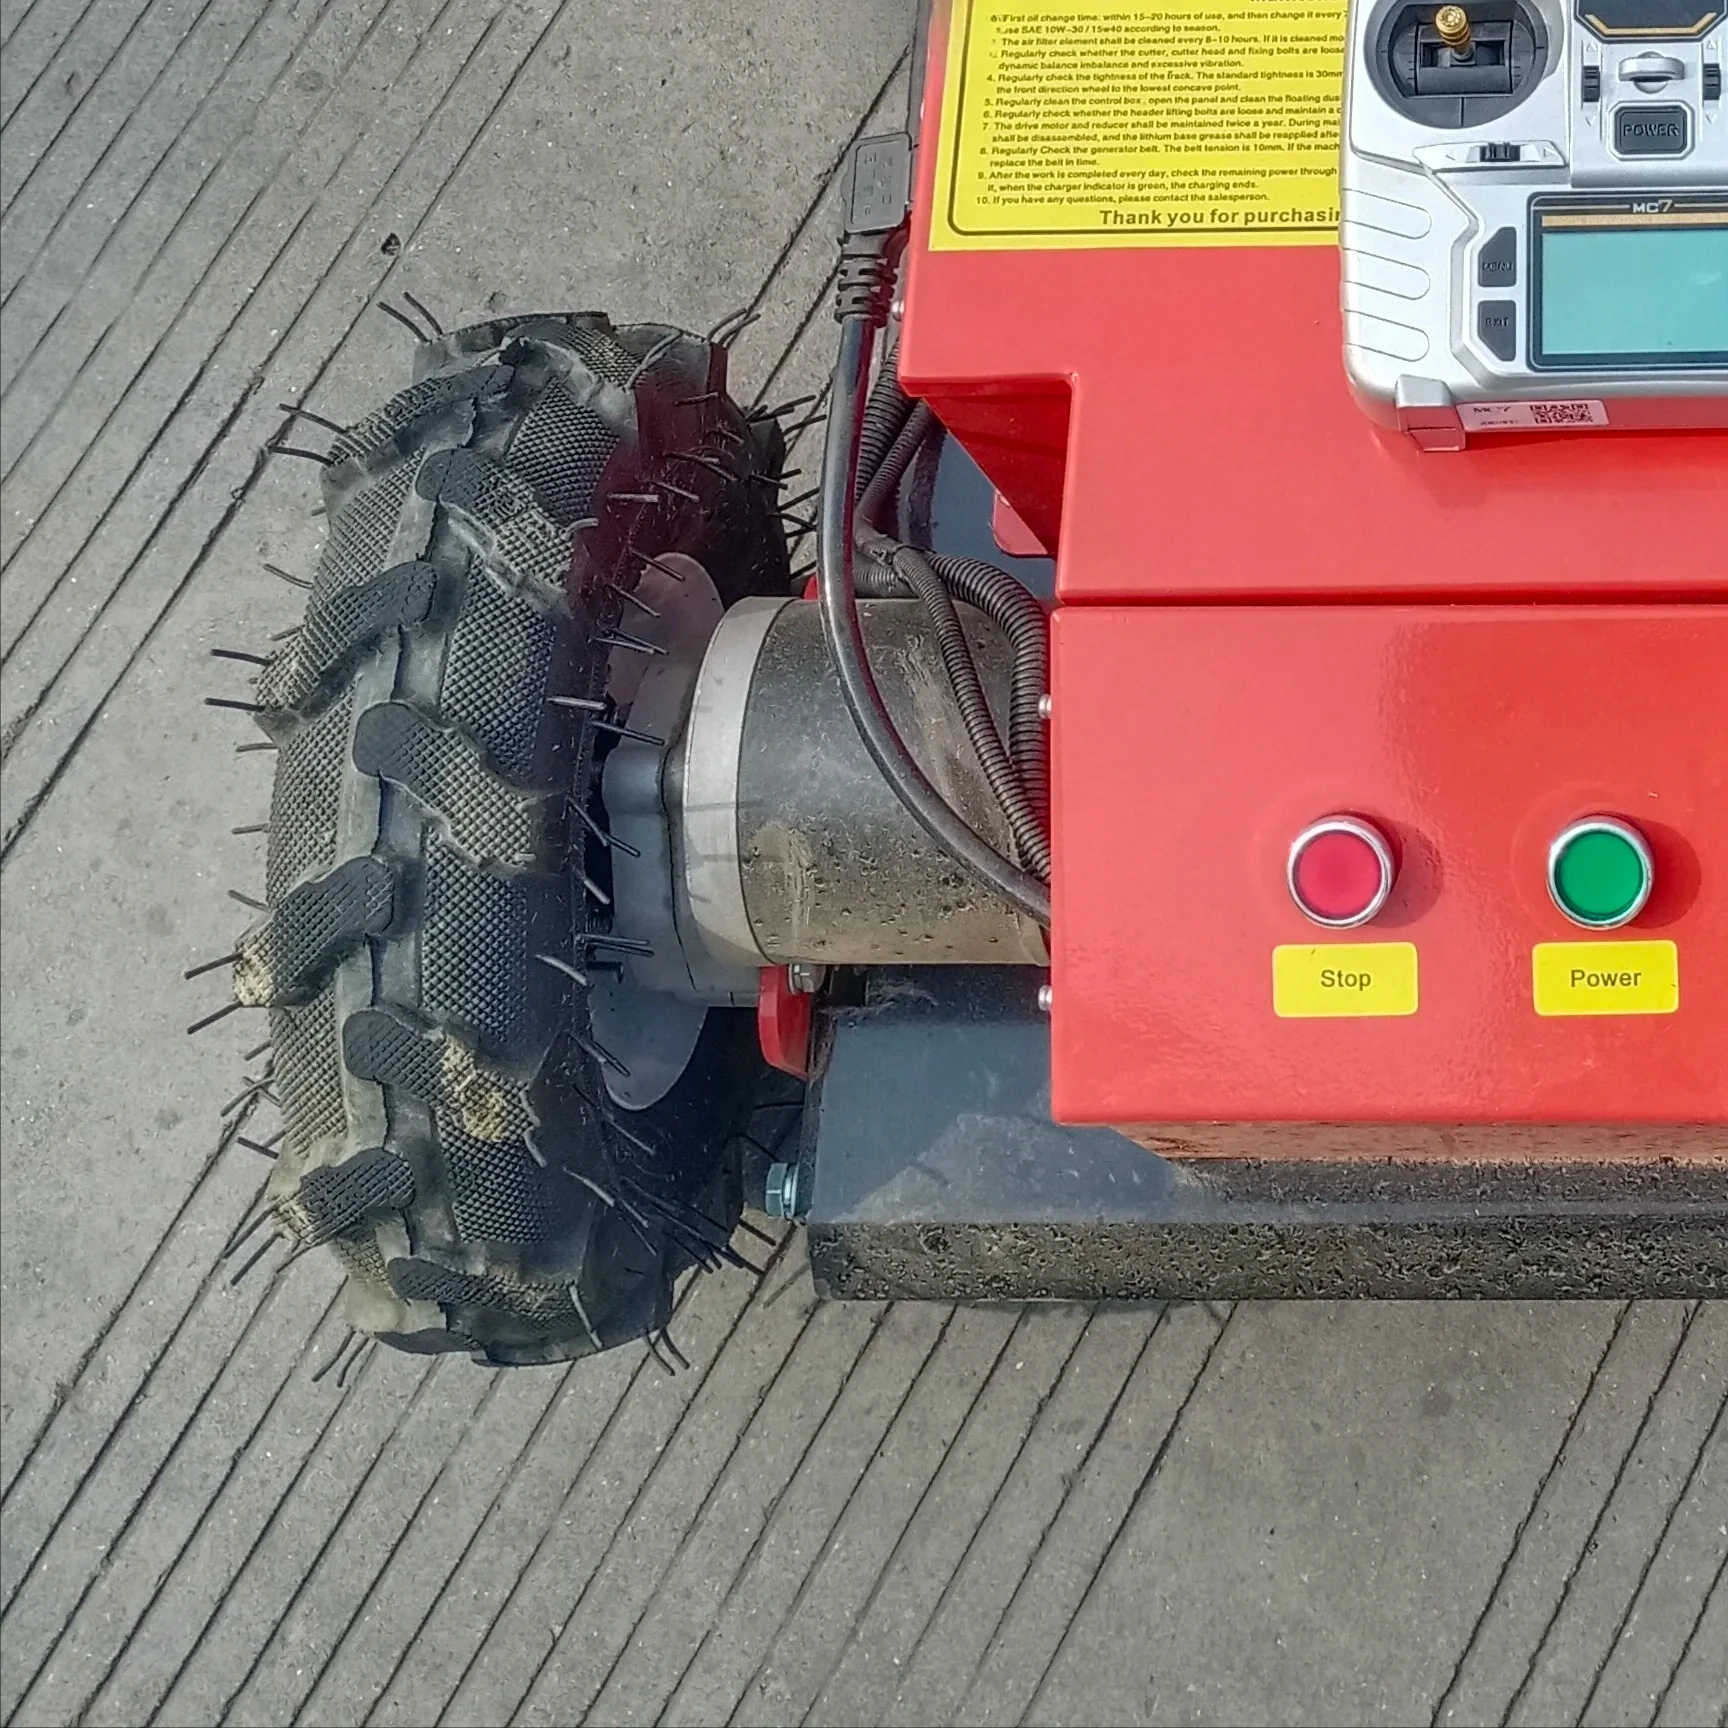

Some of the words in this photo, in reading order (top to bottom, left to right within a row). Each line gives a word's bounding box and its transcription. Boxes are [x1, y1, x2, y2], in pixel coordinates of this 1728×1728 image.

[1041, 14, 1075, 23] change
[1165, 12, 1191, 20] hours
[1270, 11, 1305, 20] change
[1315, 11, 1342, 20] every
[1124, 24, 1170, 33] according
[1002, 38, 1019, 46] The
[1059, 37, 1098, 46] element
[1099, 37, 1122, 45] shall
[1138, 36, 1175, 44] cleaned
[1178, 36, 1203, 45] every
[1001, 50, 1046, 59] Regularly
[1049, 49, 1076, 58] check
[1080, 49, 1118, 57] whether
[1121, 49, 1136, 57] the
[1171, 47, 1198, 56] cutter
[1201, 47, 1225, 55] head
[1228, 47, 1245, 55] and
[1248, 47, 1274, 56] fixing
[1277, 46, 1300, 54] bolts
[998, 62, 1039, 71] dynamic
[1041, 62, 1078, 70] balance
[1080, 61, 1129, 69] imbalance
[1131, 61, 1149, 69] and
[1151, 60, 1198, 68] excessive
[998, 74, 1044, 83] Regularly
[1046, 73, 1074, 81] check
[1076, 73, 1091, 81] the
[1093, 73, 1136, 82] tightness
[1150, 72, 1165, 80] the
[1217, 71, 1258, 79] standard
[1260, 70, 1304, 80] tightness
[996, 86, 1011, 94] the
[1038, 85, 1079, 93] direction
[1082, 85, 1109, 93] wheel
[1123, 84, 1138, 92] the
[996, 98, 1041, 107] Regularly
[1044, 97, 1070, 105] clean
[1071, 97, 1086, 105] the
[1089, 97, 1122, 105] control
[1148, 97, 1172, 105] open
[1174, 96, 1189, 104] the
[1192, 96, 1218, 104] panel
[1220, 95, 1238, 104] and
[1268, 95, 1283, 103] the
[1285, 95, 1320, 104] floating
[994, 110, 1040, 119] Regularly
[1043, 109, 1071, 117] check
[1073, 109, 1111, 117] whether
[1113, 109, 1128, 117] the
[1130, 109, 1164, 117] header
[1238, 107, 1264, 115] loose
[994, 122, 1012, 130] The
[1041, 121, 1069, 129] motor
[1071, 121, 1089, 129] and
[1092, 121, 1128, 129] reducer
[1131, 121, 1153, 129] shall
[1156, 120, 1168, 128] be
[1170, 120, 1224, 128] maintained
[1288, 119, 1320, 128] During
[1623, 123, 1680, 137] POWER
[992, 134, 1015, 142] shall
[1017, 134, 1028, 142] be
[1102, 133, 1120, 141] and
[1122, 133, 1137, 141] the
[1140, 132, 1171, 140] lithium
[1173, 132, 1197, 140] base
[1199, 133, 1232, 141] grease
[1273, 131, 1318, 140] reapplied
[992, 147, 1038, 156] Regularly
[1040, 146, 1071, 154] Check
[1073, 146, 1088, 154] the
[1090, 146, 1138, 155] generator
[1164, 144, 1182, 152] The
[990, 159, 1025, 168] replace
[989, 171, 1013, 179] After
[1015, 171, 1030, 179] the
[1067, 170, 1117, 179] completed
[1120, 171, 1146, 179] every
[1171, 169, 1199, 177] check
[1219, 168, 1266, 177] remaining
[1268, 169, 1298, 177] power
[1300, 167, 1337, 176] through
[999, 184, 1025, 192] when
[1044, 183, 1081, 192] charger
[1083, 183, 1125, 191] indicator
[1171, 181, 1186, 189] the
[1188, 181, 1230, 190] charging
[1001, 197, 1019, 206] you
[1021, 194, 1045, 204] have
[1047, 197, 1064, 205] any
[1119, 195, 1151, 204] please
[1191, 193, 1206, 201] the
[1208, 193, 1269, 202] salesperson.
[1632, 199, 1673, 213] MC7
[1099, 210, 1162, 224] Thank
[1167, 211, 1204, 227] you
[1210, 208, 1239, 224] for
[1320, 969, 1372, 992] Stop
[1570, 969, 1642, 987] Power
